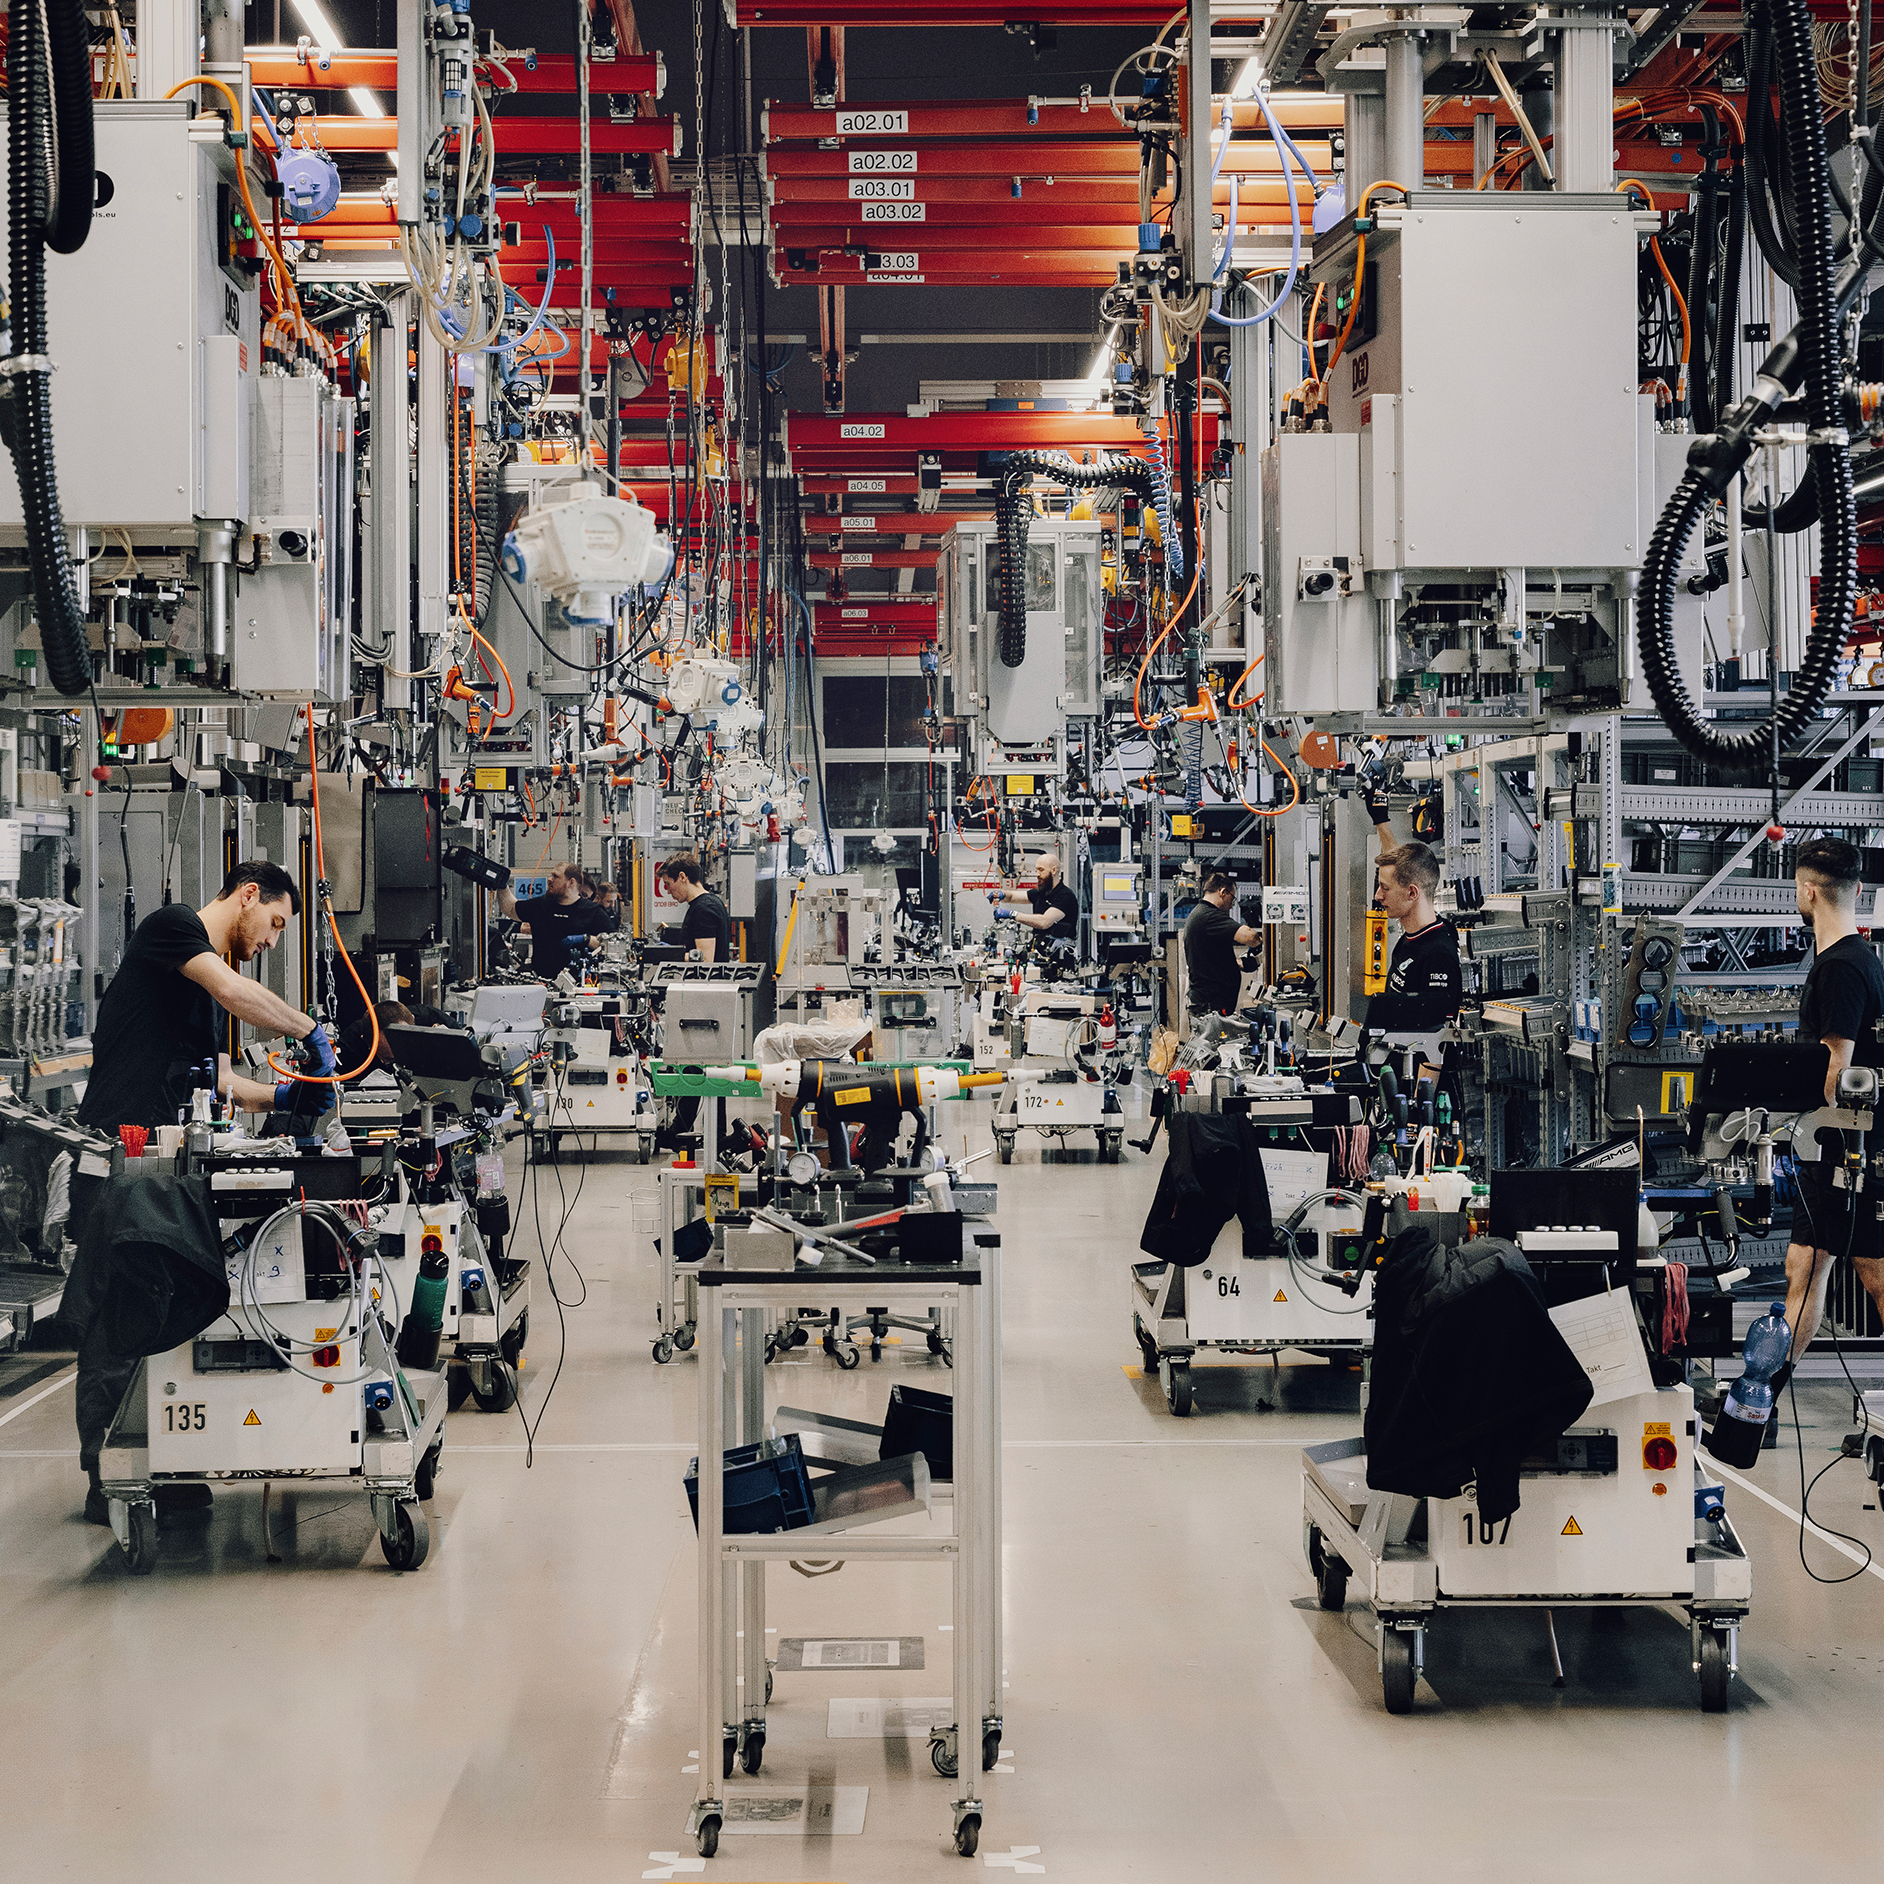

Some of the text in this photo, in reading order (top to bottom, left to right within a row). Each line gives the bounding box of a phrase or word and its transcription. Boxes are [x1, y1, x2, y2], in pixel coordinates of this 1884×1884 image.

[843, 114, 902, 130] a02.01
[853, 154, 913, 169] a02.02
[854, 182, 909, 197] a03.01
[866, 204, 921, 219] a03.02
[882, 255, 915, 268] 3.03
[843, 426, 882, 437] a04.02
[850, 481, 883, 490] a04.05
[843, 518, 873, 526] a05.01
[844, 554, 871, 562] a06.01
[518, 883, 543, 895] 465
[979, 1045, 993, 1055] 152
[557, 1097, 573, 1109] 130
[1025, 1097, 1042, 1108] 172
[1600, 1143, 1634, 1165] AMG
[1300, 1190, 1306, 1198] 2
[1218, 1276, 1240, 1297] 64
[1586, 1364, 1602, 1374] Takt
[165, 1404, 206, 1431] 135
[1463, 1513, 1511, 1544] 107
